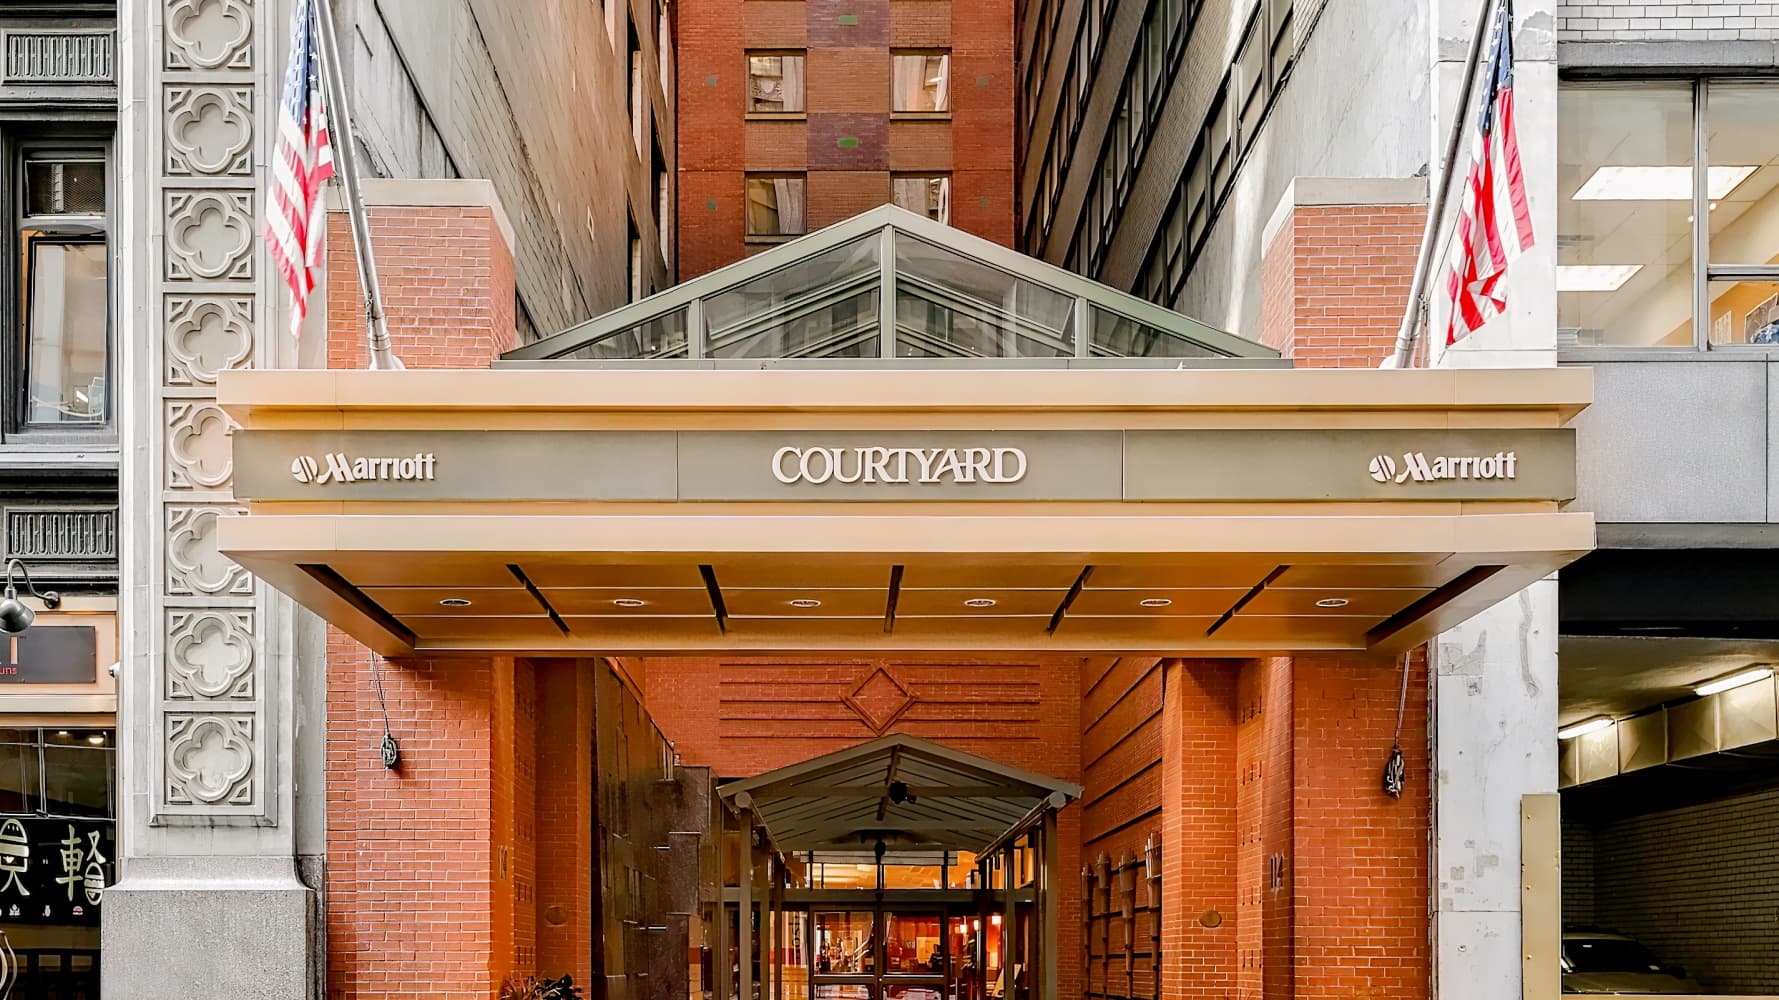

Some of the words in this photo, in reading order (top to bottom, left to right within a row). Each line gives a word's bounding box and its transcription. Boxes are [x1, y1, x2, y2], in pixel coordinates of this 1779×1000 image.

[316, 452, 436, 485] Marriott
[771, 446, 1027, 484] COURTYARD
[1394, 451, 1517, 484] Marriott
